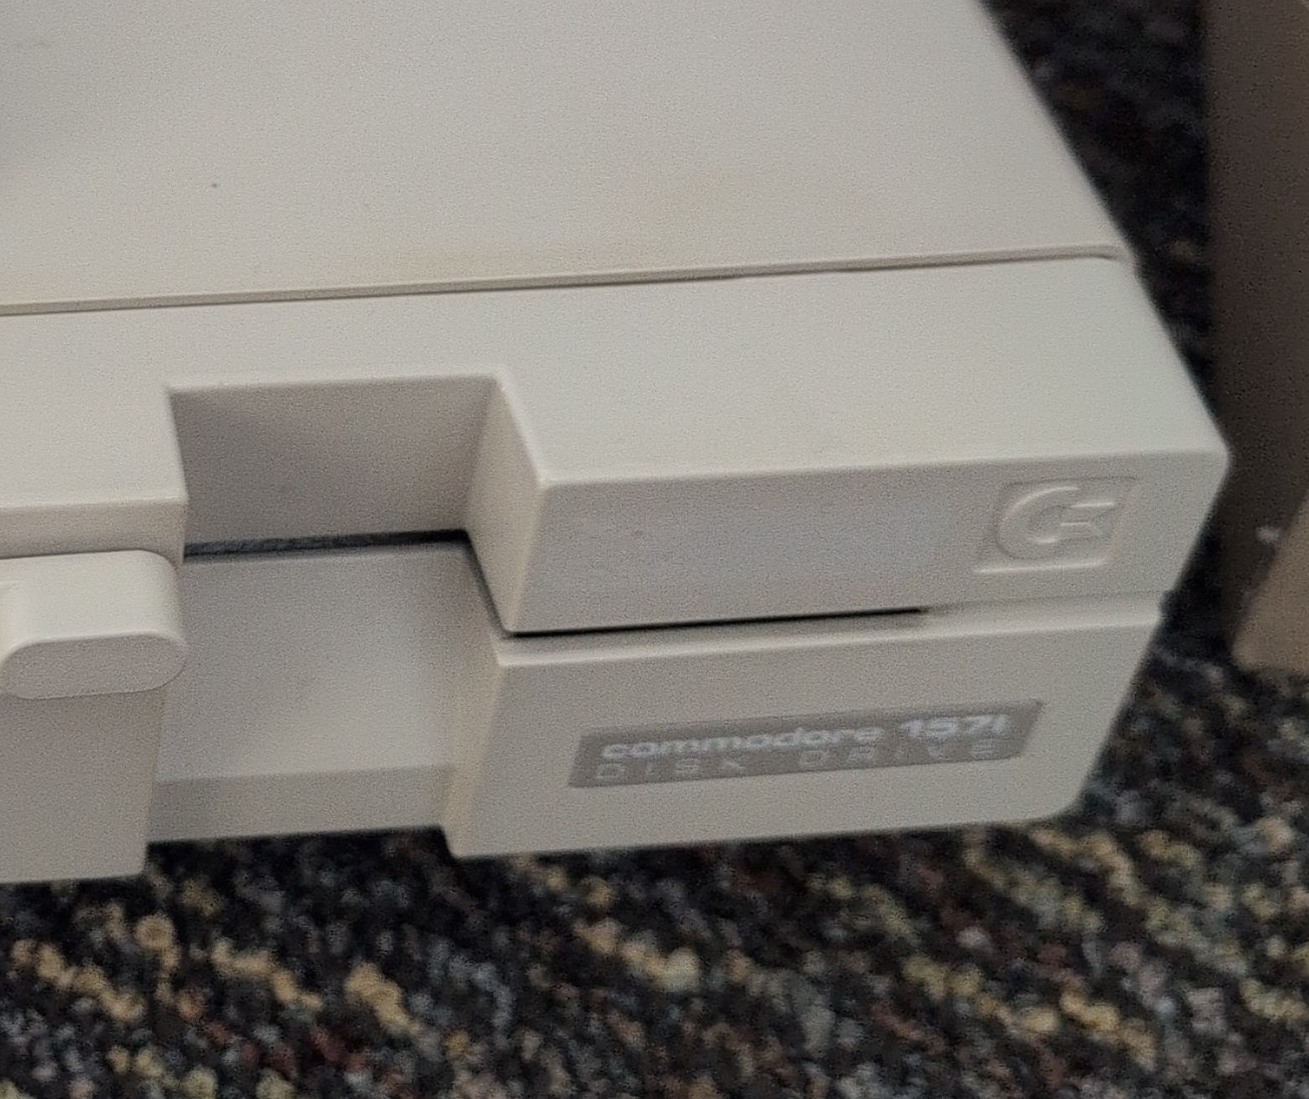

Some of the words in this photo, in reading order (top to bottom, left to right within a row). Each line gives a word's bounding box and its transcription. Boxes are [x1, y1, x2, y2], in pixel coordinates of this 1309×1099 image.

[600, 726, 885, 759] commodore
[898, 713, 1011, 741] 1571
[594, 755, 746, 781] DISK
[797, 737, 1000, 770] DRIVE
